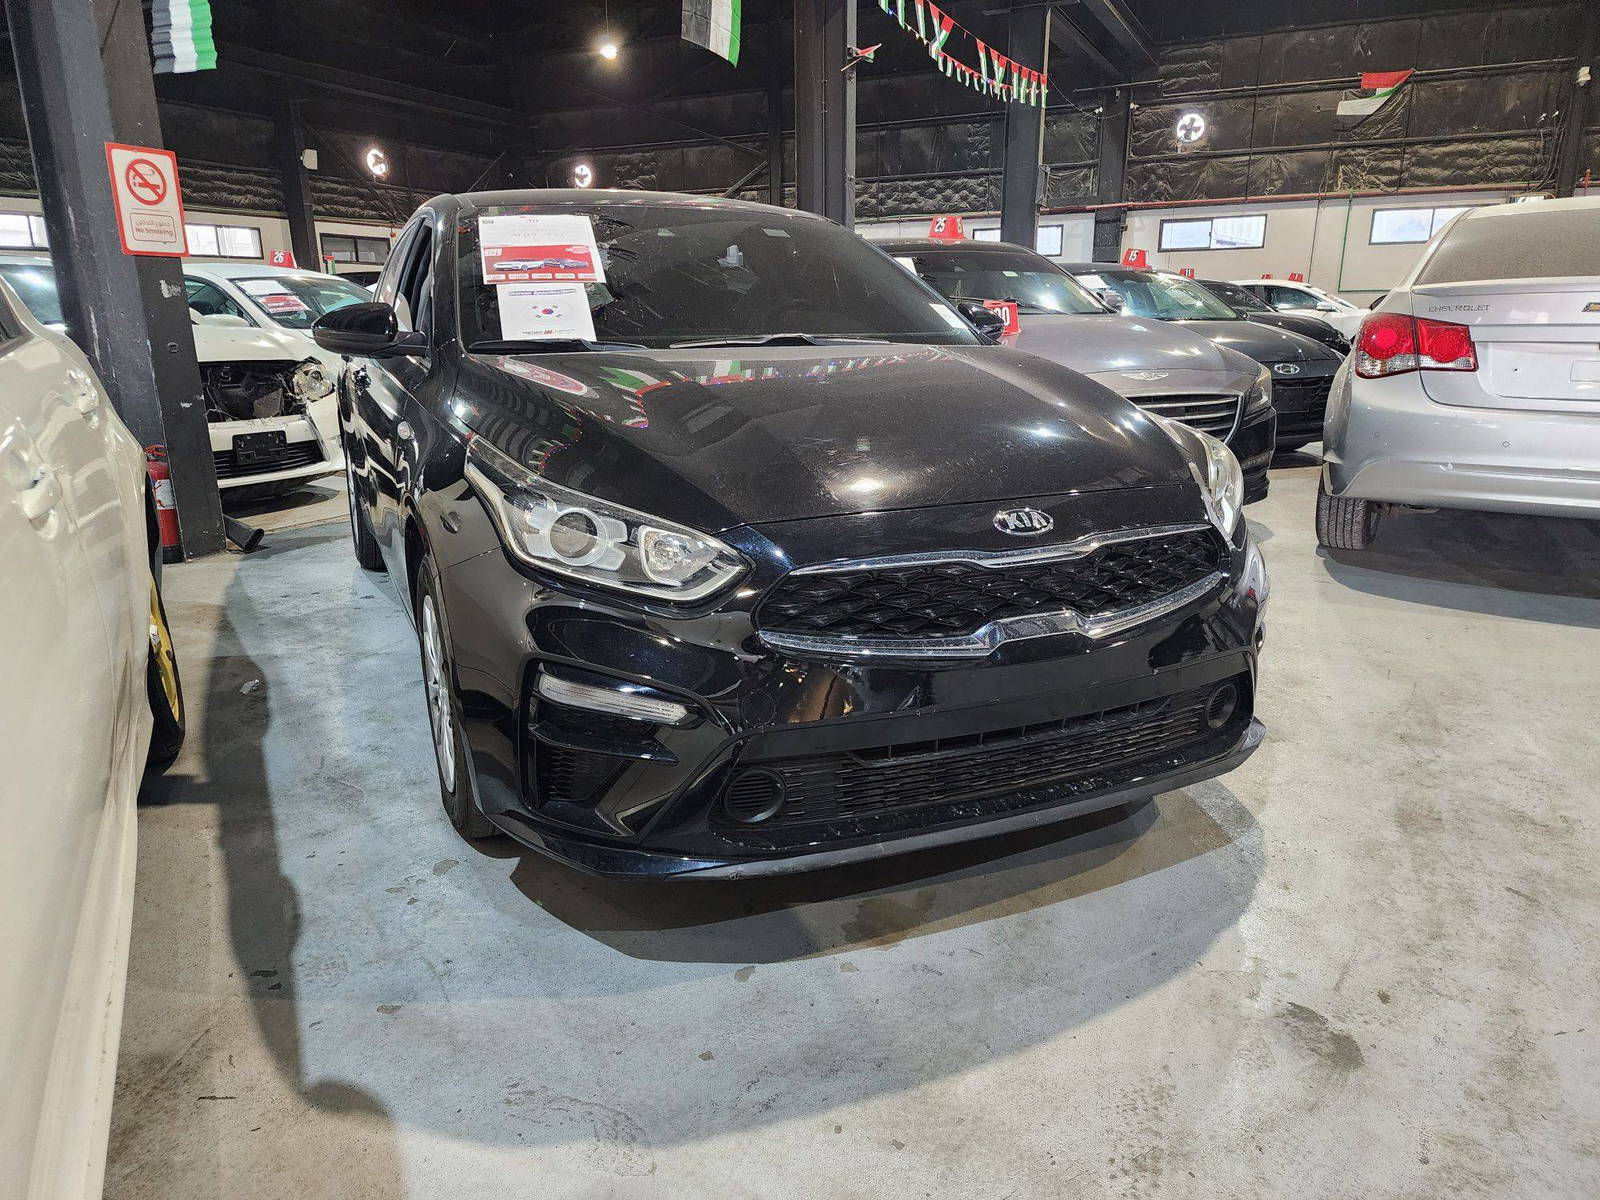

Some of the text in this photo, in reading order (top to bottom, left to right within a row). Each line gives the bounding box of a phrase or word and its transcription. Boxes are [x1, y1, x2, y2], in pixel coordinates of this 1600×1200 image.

[934, 216, 947, 233] 25
[145, 228, 173, 236] Smoking
[273, 251, 284, 263] 26
[1128, 250, 1139, 262] 15
[1428, 304, 1491, 313] CHEVROLET
[1001, 511, 1049, 531] KIA
